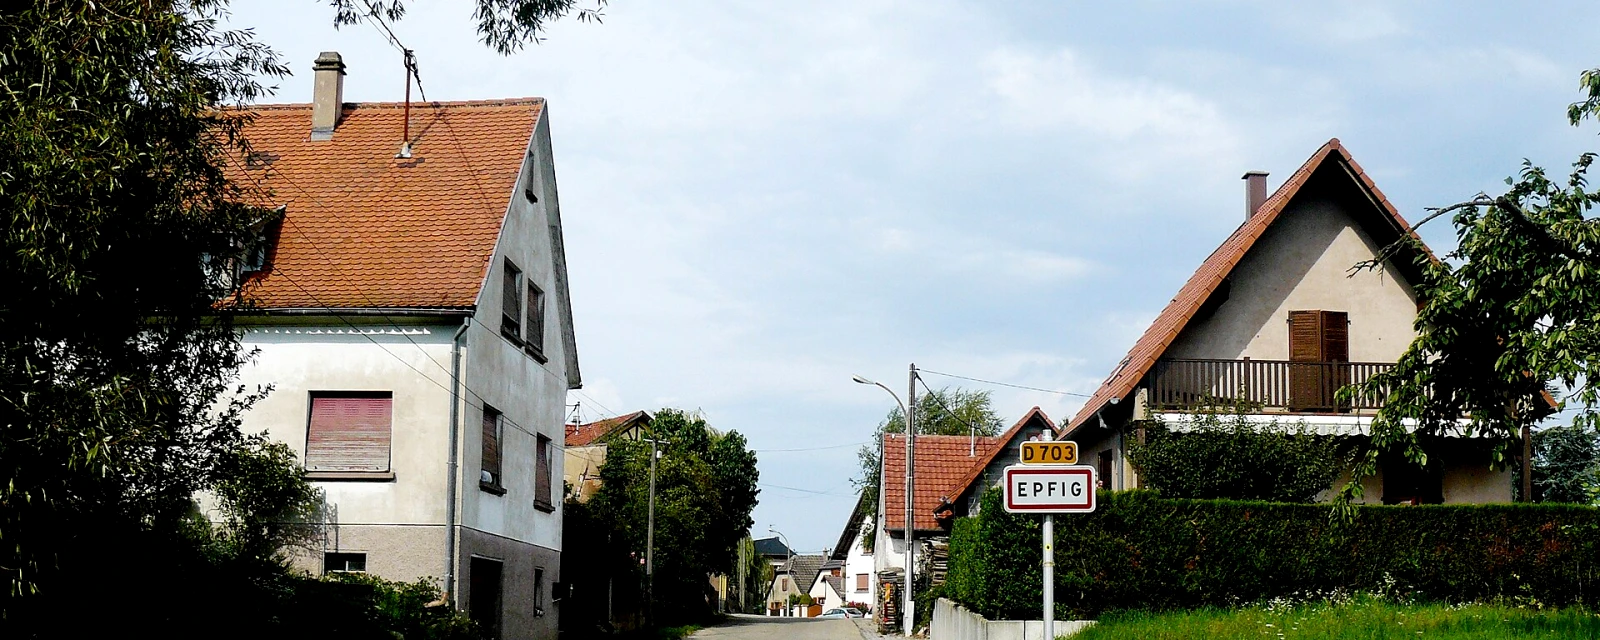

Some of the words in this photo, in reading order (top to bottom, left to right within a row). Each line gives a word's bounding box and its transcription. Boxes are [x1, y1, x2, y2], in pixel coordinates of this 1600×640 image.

[1023, 446, 1034, 461] D
[1039, 446, 1074, 461] 703
[1017, 482, 1082, 497] EPFIG
